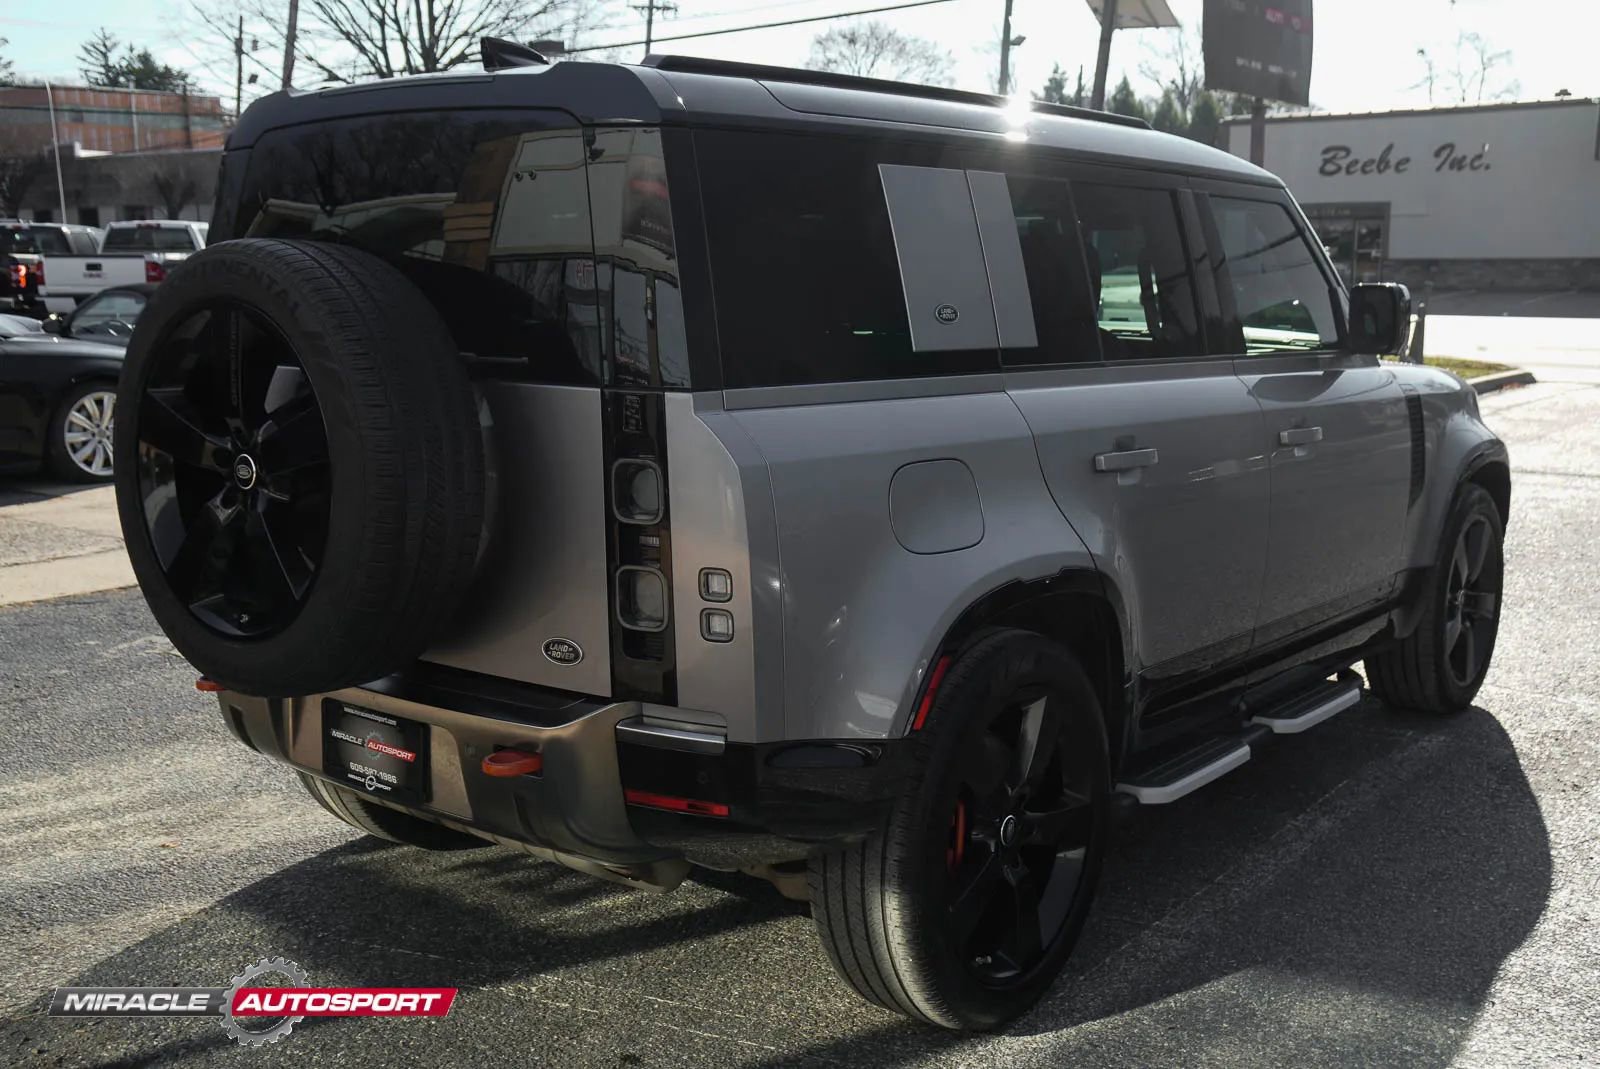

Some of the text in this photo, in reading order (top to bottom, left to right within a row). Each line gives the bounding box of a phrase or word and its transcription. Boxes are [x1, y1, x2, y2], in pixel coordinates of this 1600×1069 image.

[1319, 142, 1492, 177] Beebe Inc.
[549, 642, 569, 653] LAND
[551, 650, 575, 661] ROVER
[331, 729, 413, 761] MIRACLE AUTOSPORT
